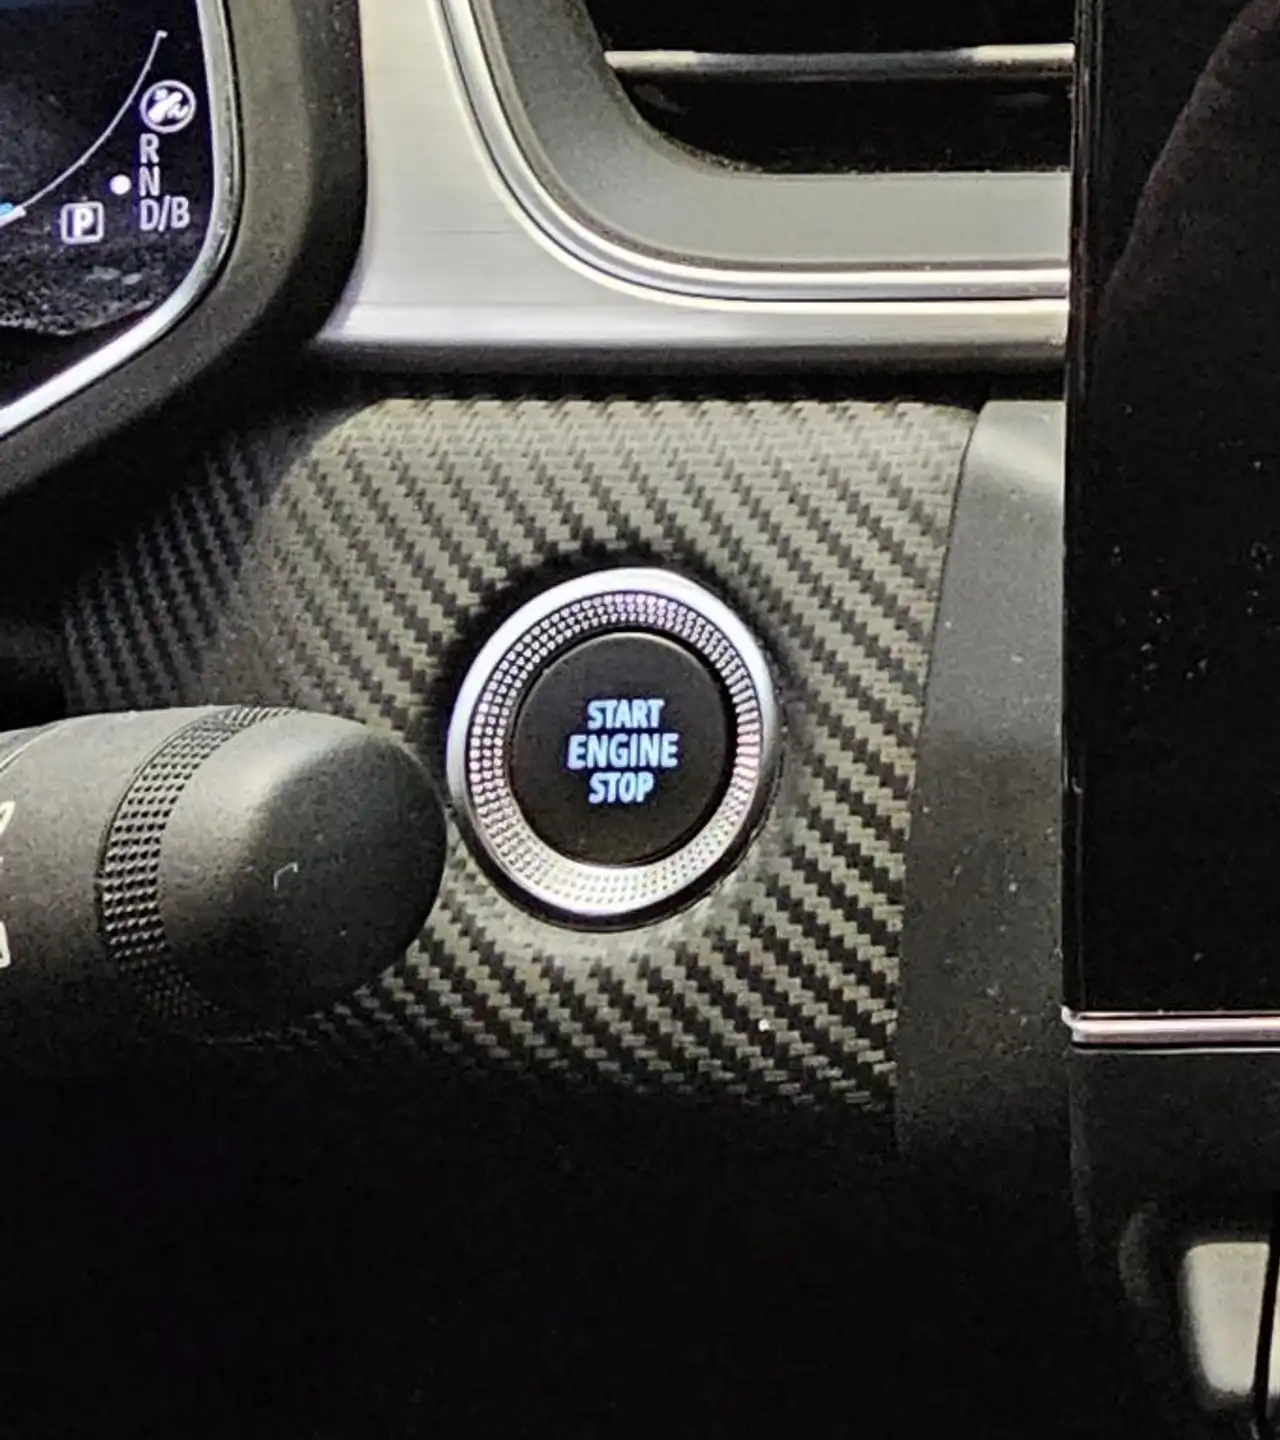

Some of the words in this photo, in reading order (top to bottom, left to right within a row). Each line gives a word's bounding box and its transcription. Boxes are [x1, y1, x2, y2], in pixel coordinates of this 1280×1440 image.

[139, 133, 160, 164] R
[138, 165, 161, 197] N
[139, 195, 191, 233] D/B
[587, 698, 665, 730] START
[567, 732, 679, 770] ENGINE
[588, 771, 655, 805] STOP
